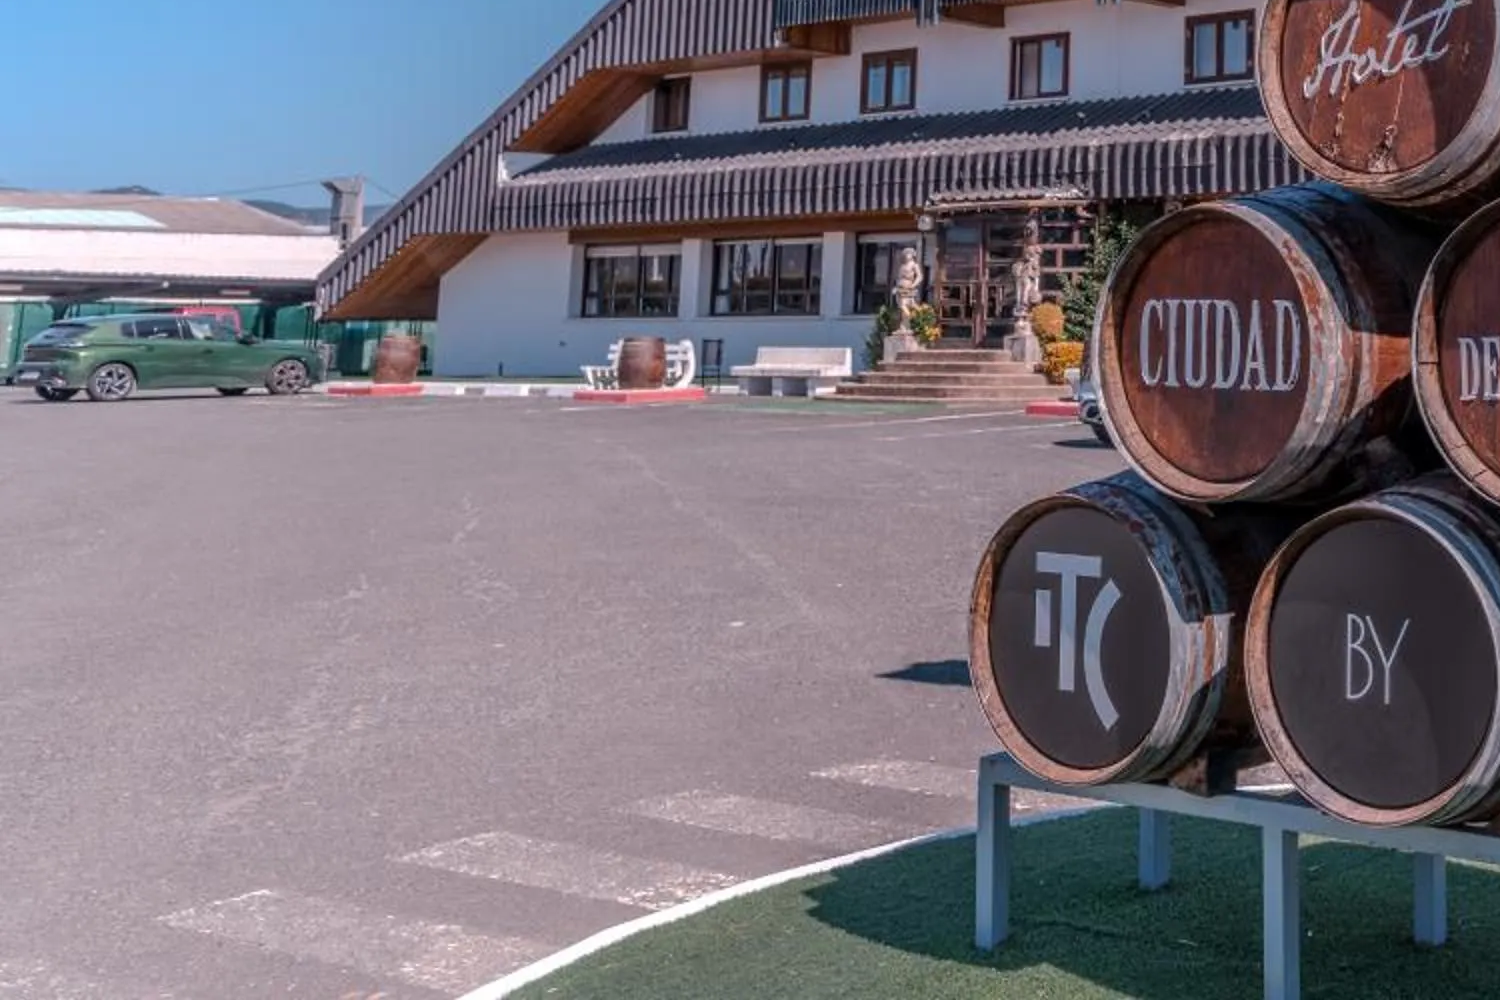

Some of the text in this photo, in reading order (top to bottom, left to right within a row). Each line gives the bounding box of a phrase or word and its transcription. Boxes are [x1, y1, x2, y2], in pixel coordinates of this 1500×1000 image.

[1139, 299, 1300, 391] CIUDAD
[1458, 336, 1500, 401] DE
[1345, 612, 1409, 704] BY
